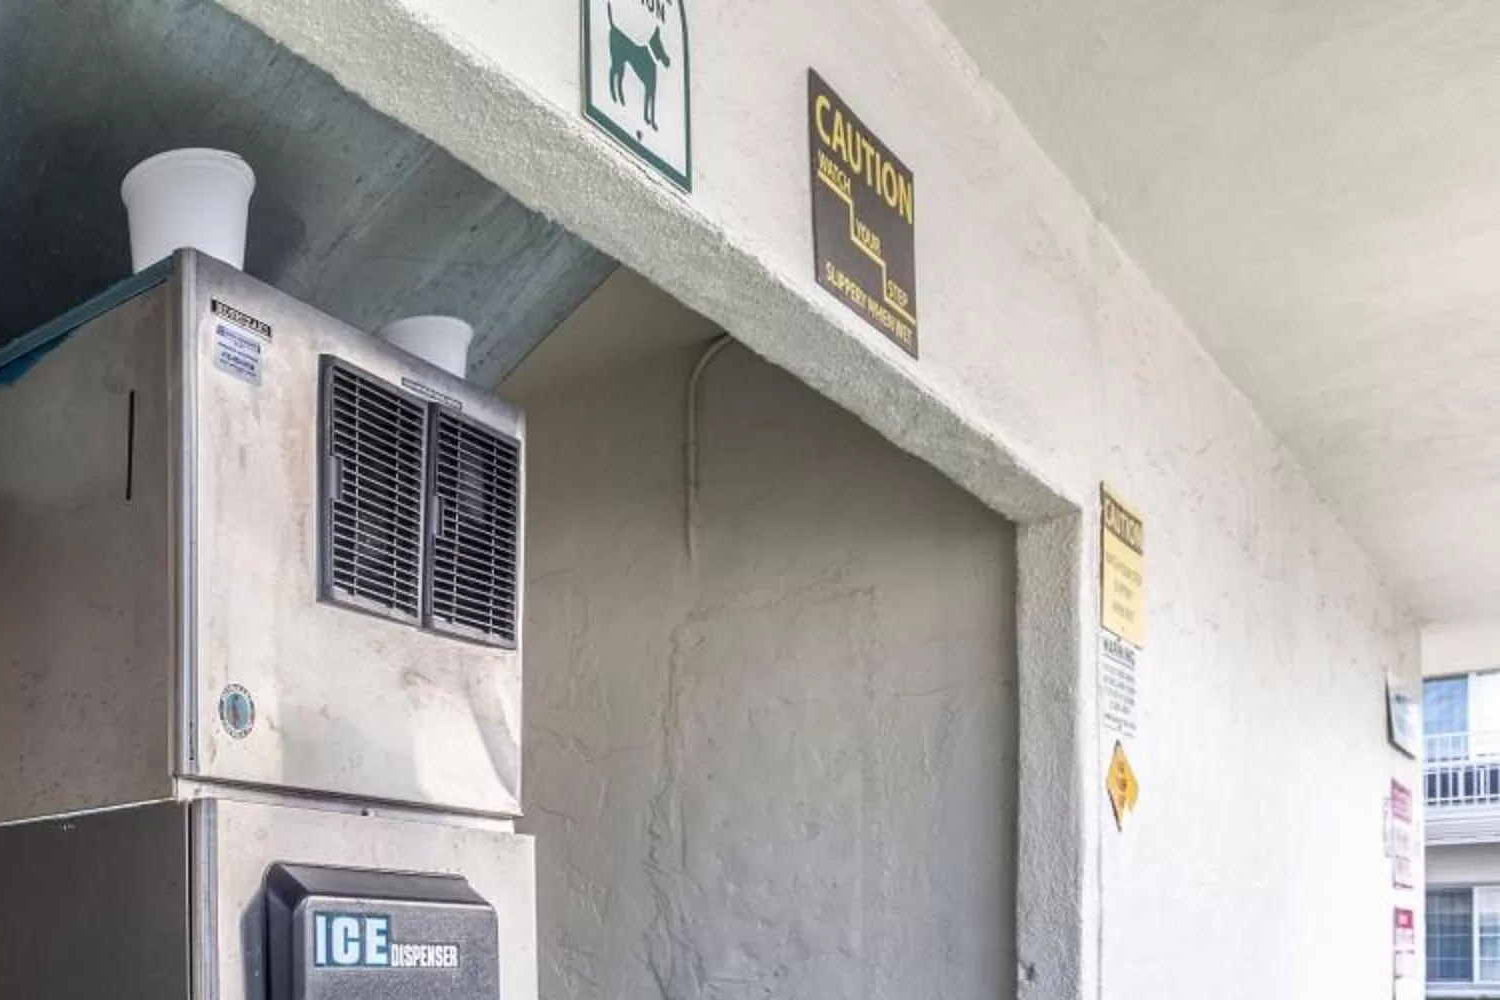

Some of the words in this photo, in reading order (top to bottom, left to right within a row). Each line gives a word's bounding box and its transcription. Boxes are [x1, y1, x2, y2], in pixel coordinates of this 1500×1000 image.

[816, 95, 913, 225] CAUTION
[818, 148, 851, 197] WATCH
[855, 218, 881, 257] YOUR
[825, 260, 867, 309] SLIPPERY
[887, 279, 909, 309] STEP
[315, 914, 389, 966] ICE
[391, 943, 459, 968] DISPENSER
